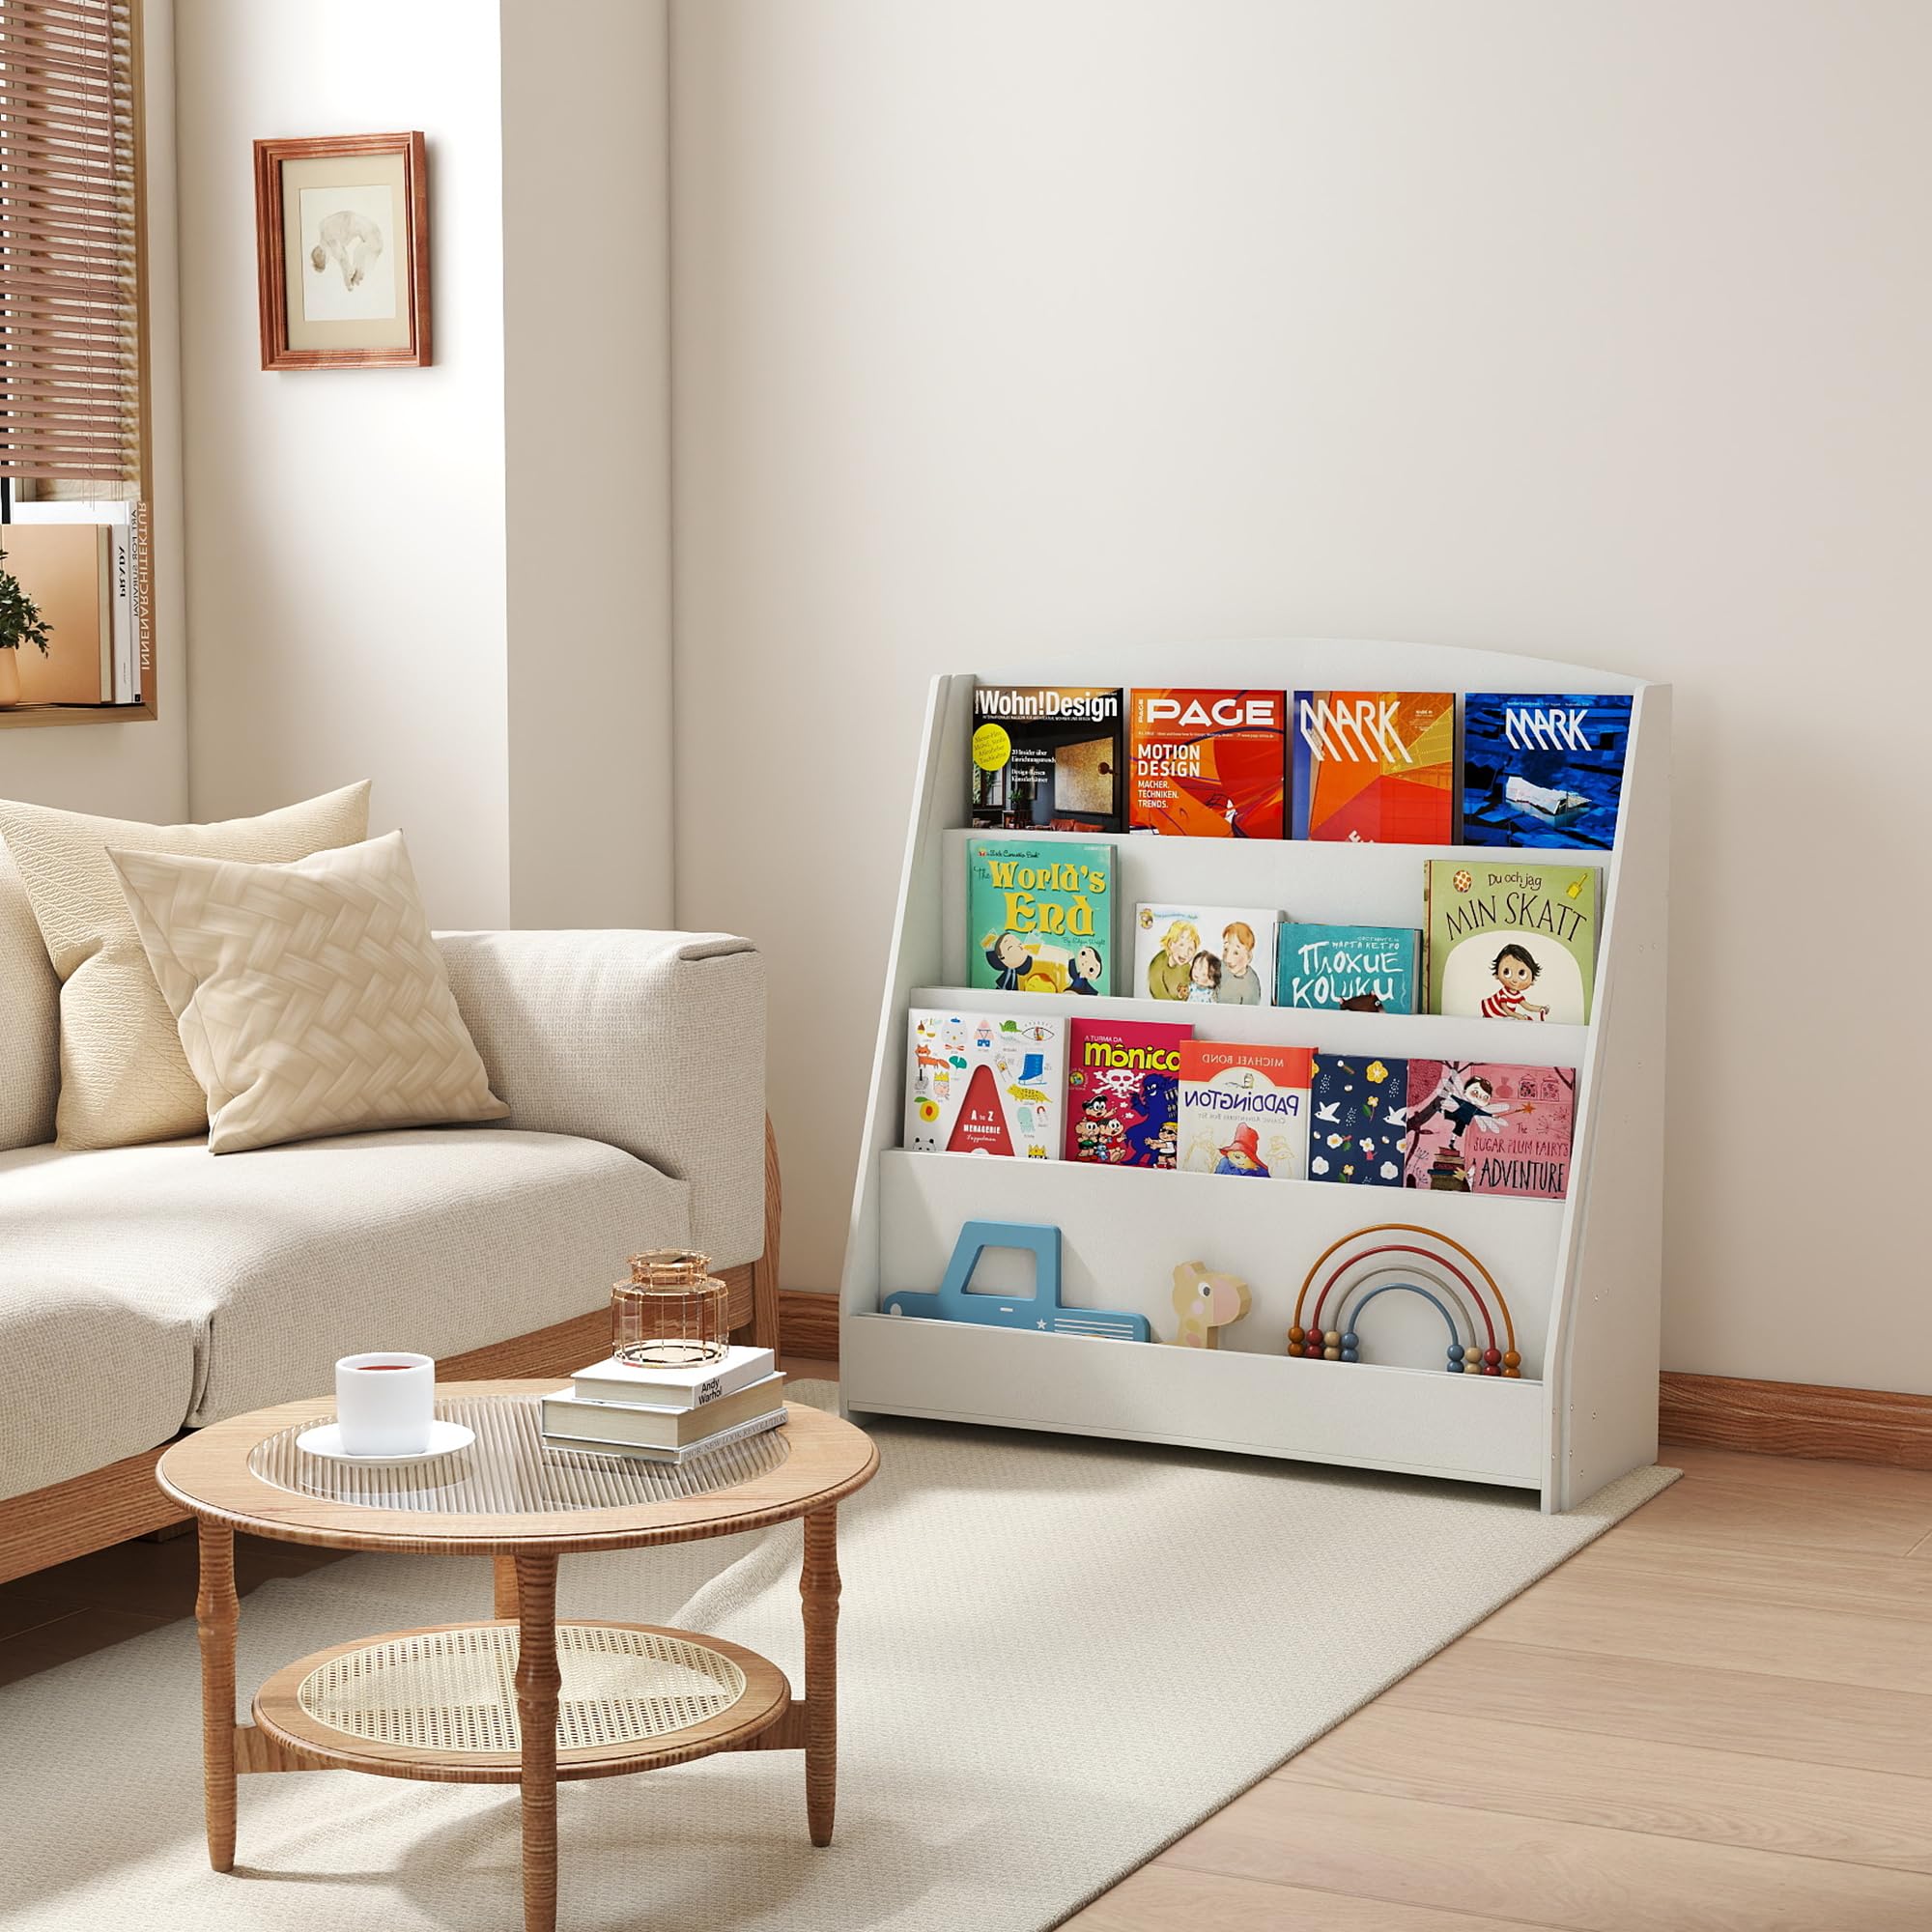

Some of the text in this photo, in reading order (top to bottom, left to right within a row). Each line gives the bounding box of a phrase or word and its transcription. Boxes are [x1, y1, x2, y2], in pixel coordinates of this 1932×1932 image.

[980, 690, 1118, 723] Wohn!Design
[1147, 698, 1274, 726] PAGE
[1300, 699, 1413, 763] MARK
[1505, 708, 1592, 751] MARK
[1138, 744, 1200, 760] MOTION
[1138, 760, 1200, 777] DESIGN
[1138, 780, 1170, 789] MACHER.
[1138, 789, 1179, 799] TECHNIKEN.
[1138, 800, 1168, 809] TRENDS.
[988, 860, 1106, 894] World's
[1488, 871, 1542, 891] Du och jag
[1004, 892, 1095, 936] End
[1446, 892, 1587, 942] MIN SKATT
[970, 1109, 978, 1121] A
[987, 1111, 994, 1122] Z
[1517, 1122, 1528, 1134] The
[1474, 1137, 1505, 1153] SUGAR
[1508, 1140, 1532, 1155] PLUM
[1479, 1157, 1565, 1193] ADVENTURE
[701, 1378, 720, 1393] Andy
[698, 1386, 722, 1405] Warhol
